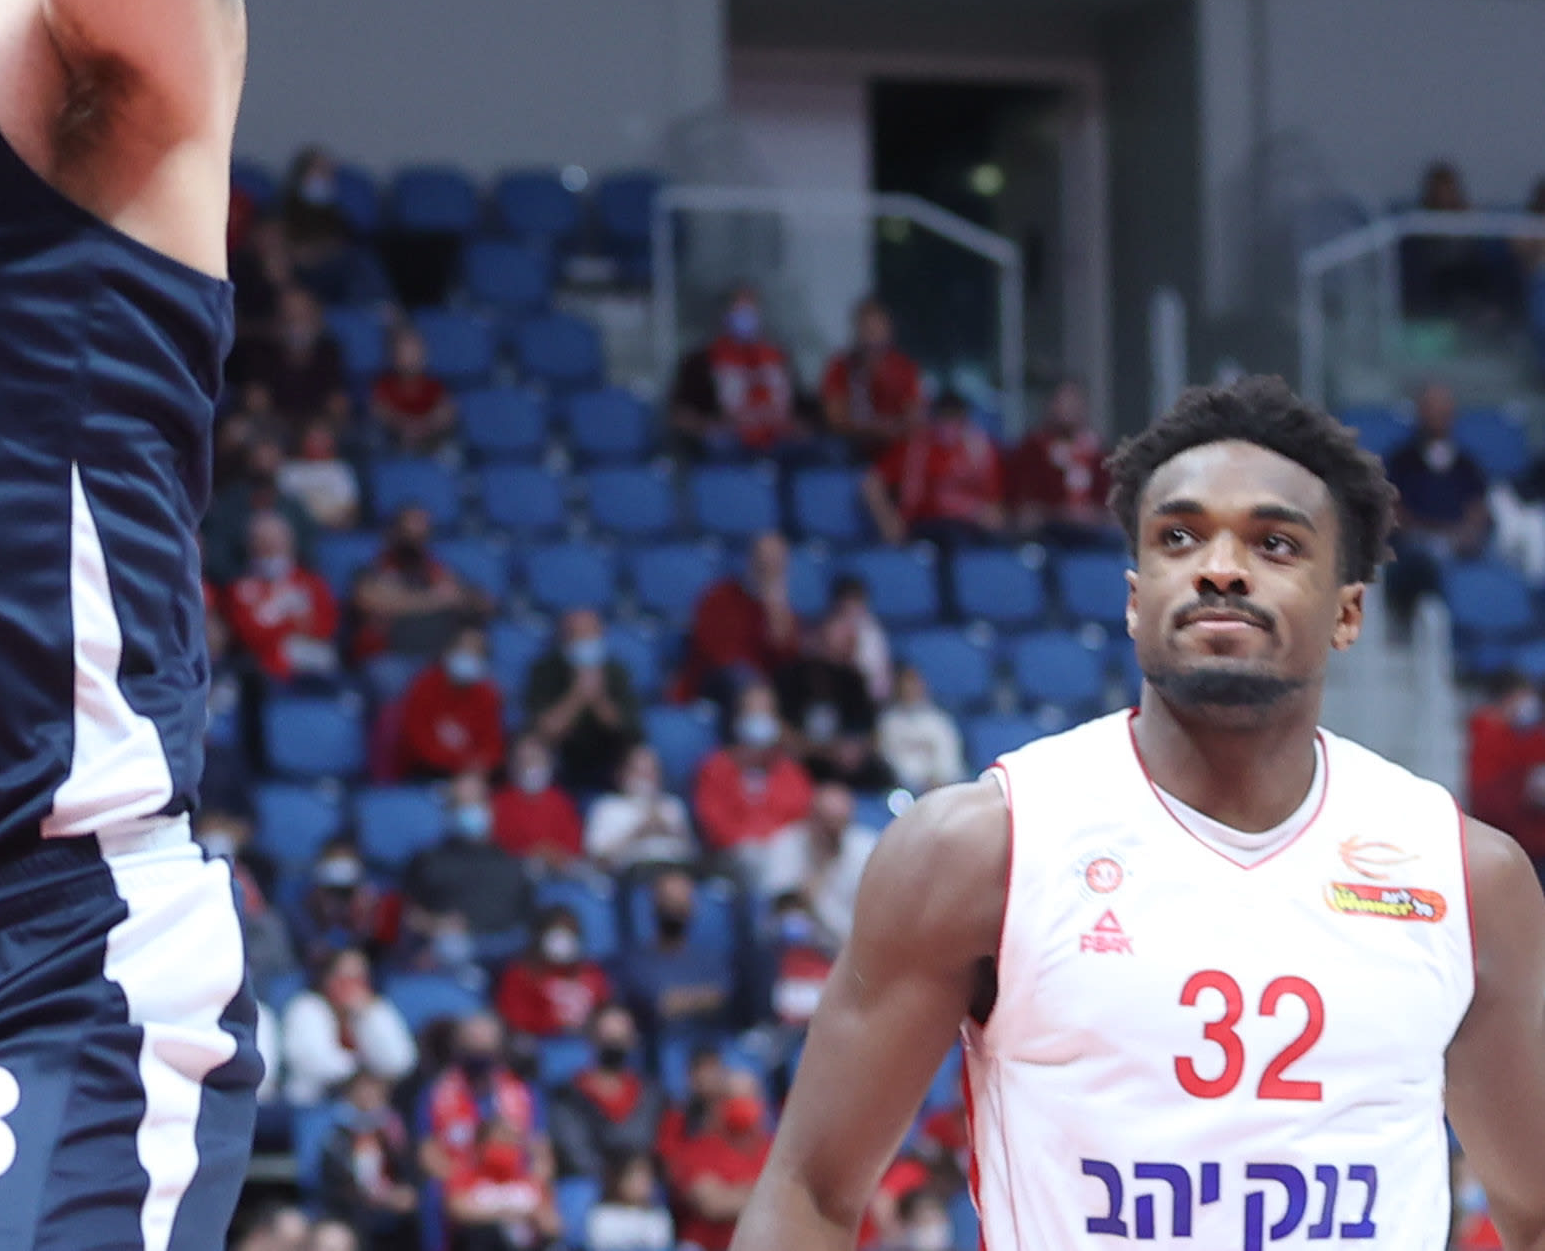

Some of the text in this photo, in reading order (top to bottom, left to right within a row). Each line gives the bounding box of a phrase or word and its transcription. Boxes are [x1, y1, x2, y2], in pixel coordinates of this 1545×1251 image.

[1174, 969, 1325, 1101] 32
[1080, 1158, 1378, 1251] בנק יהב
